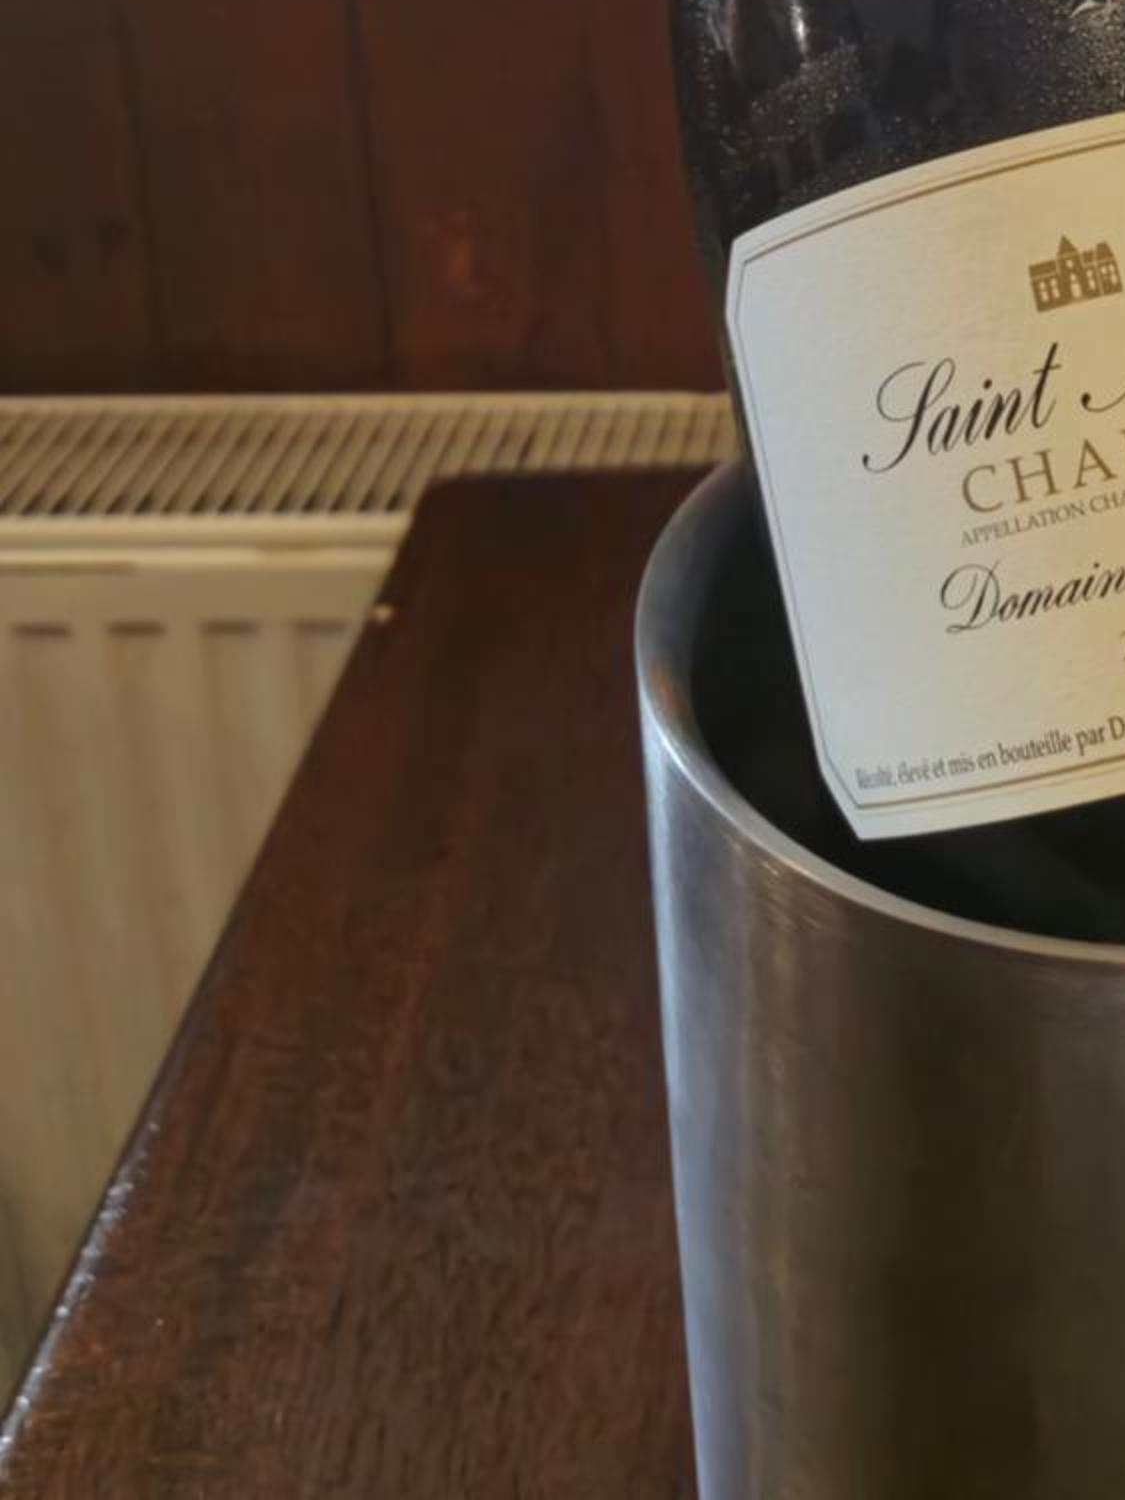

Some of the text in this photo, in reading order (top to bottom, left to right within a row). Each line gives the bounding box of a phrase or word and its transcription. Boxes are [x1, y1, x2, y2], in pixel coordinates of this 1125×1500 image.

[862, 342, 1063, 474] Saint
[960, 498, 1087, 548] APPELLATION
[948, 750, 977, 776] mis
[977, 747, 998, 771] en
[998, 728, 1073, 767] bouteille
[1075, 724, 1106, 757] par
